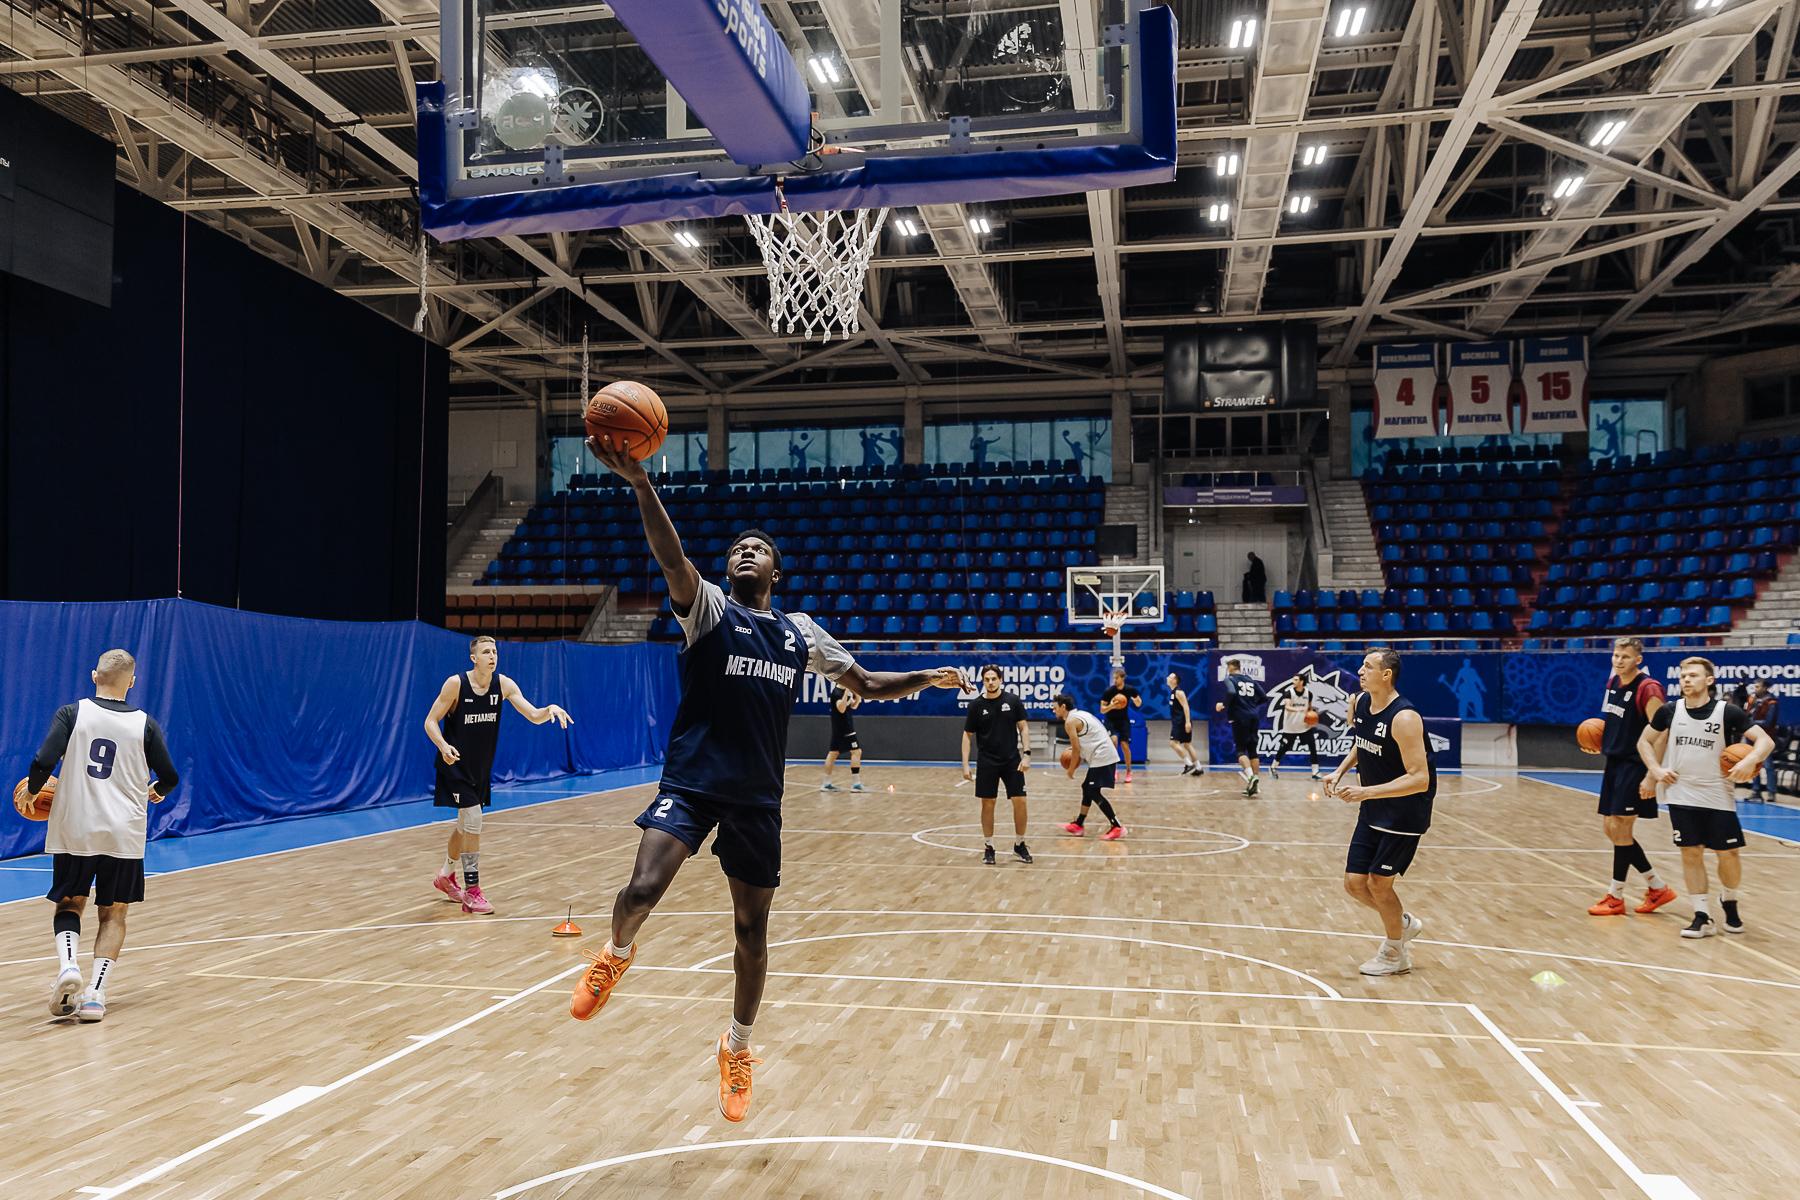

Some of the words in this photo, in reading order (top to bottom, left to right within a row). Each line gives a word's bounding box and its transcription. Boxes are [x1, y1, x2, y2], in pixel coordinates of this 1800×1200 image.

[718, 0, 766, 78] sports
[1396, 377, 1415, 406] 4
[1470, 375, 1490, 404] 5
[1537, 371, 1571, 401] 15
[1384, 416, 1428, 426] МАГНИТКА
[1457, 413, 1502, 424] МАГНИТКА
[1531, 410, 1578, 421] МАГНИТКА
[784, 630, 796, 652] 2
[724, 654, 797, 689] МЕТАЛЛУРГ
[1238, 681, 1255, 697] 35
[490, 694, 499, 706] 17
[1374, 722, 1387, 738] 21
[1704, 722, 1721, 734] 32
[87, 738, 117, 780] 9
[654, 798, 673, 818] 2
